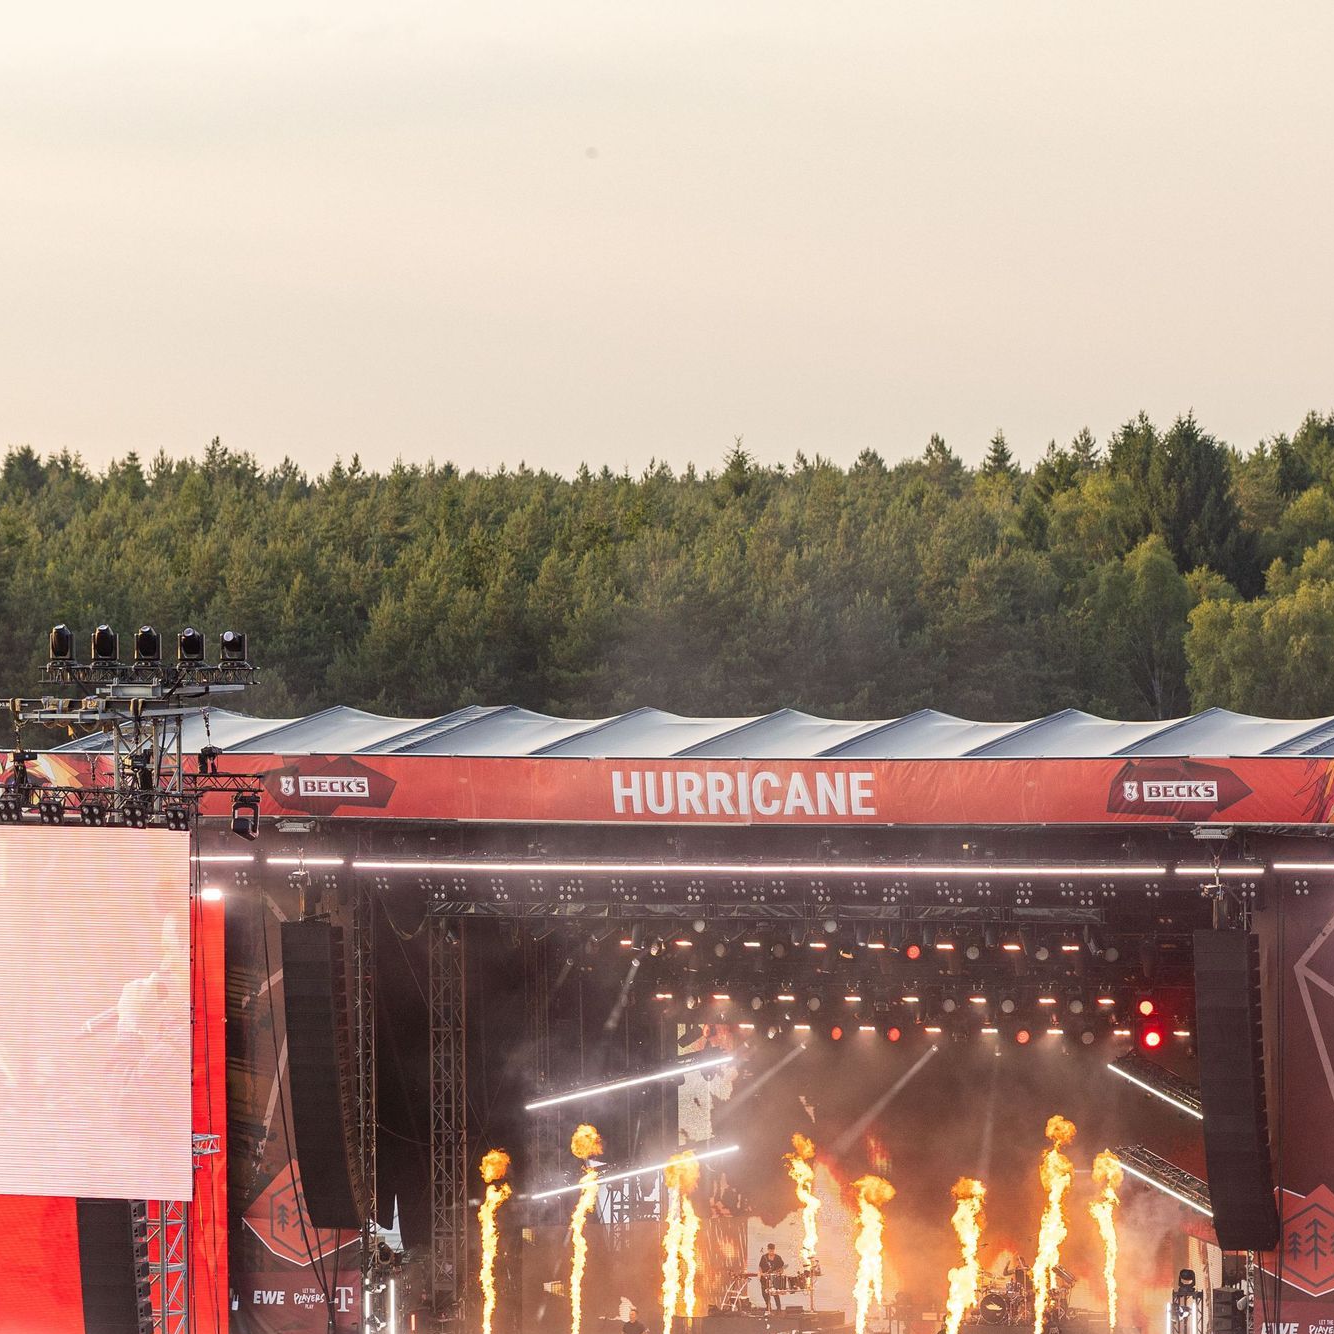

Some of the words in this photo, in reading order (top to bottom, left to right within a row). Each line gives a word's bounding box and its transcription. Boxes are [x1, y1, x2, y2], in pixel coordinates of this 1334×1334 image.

[303, 777, 366, 793] BECK'S
[611, 770, 877, 816] HURRICANE
[1147, 781, 1215, 798] BECK'S
[253, 1290, 286, 1305] EWE
[293, 1292, 325, 1305] PLAYERS
